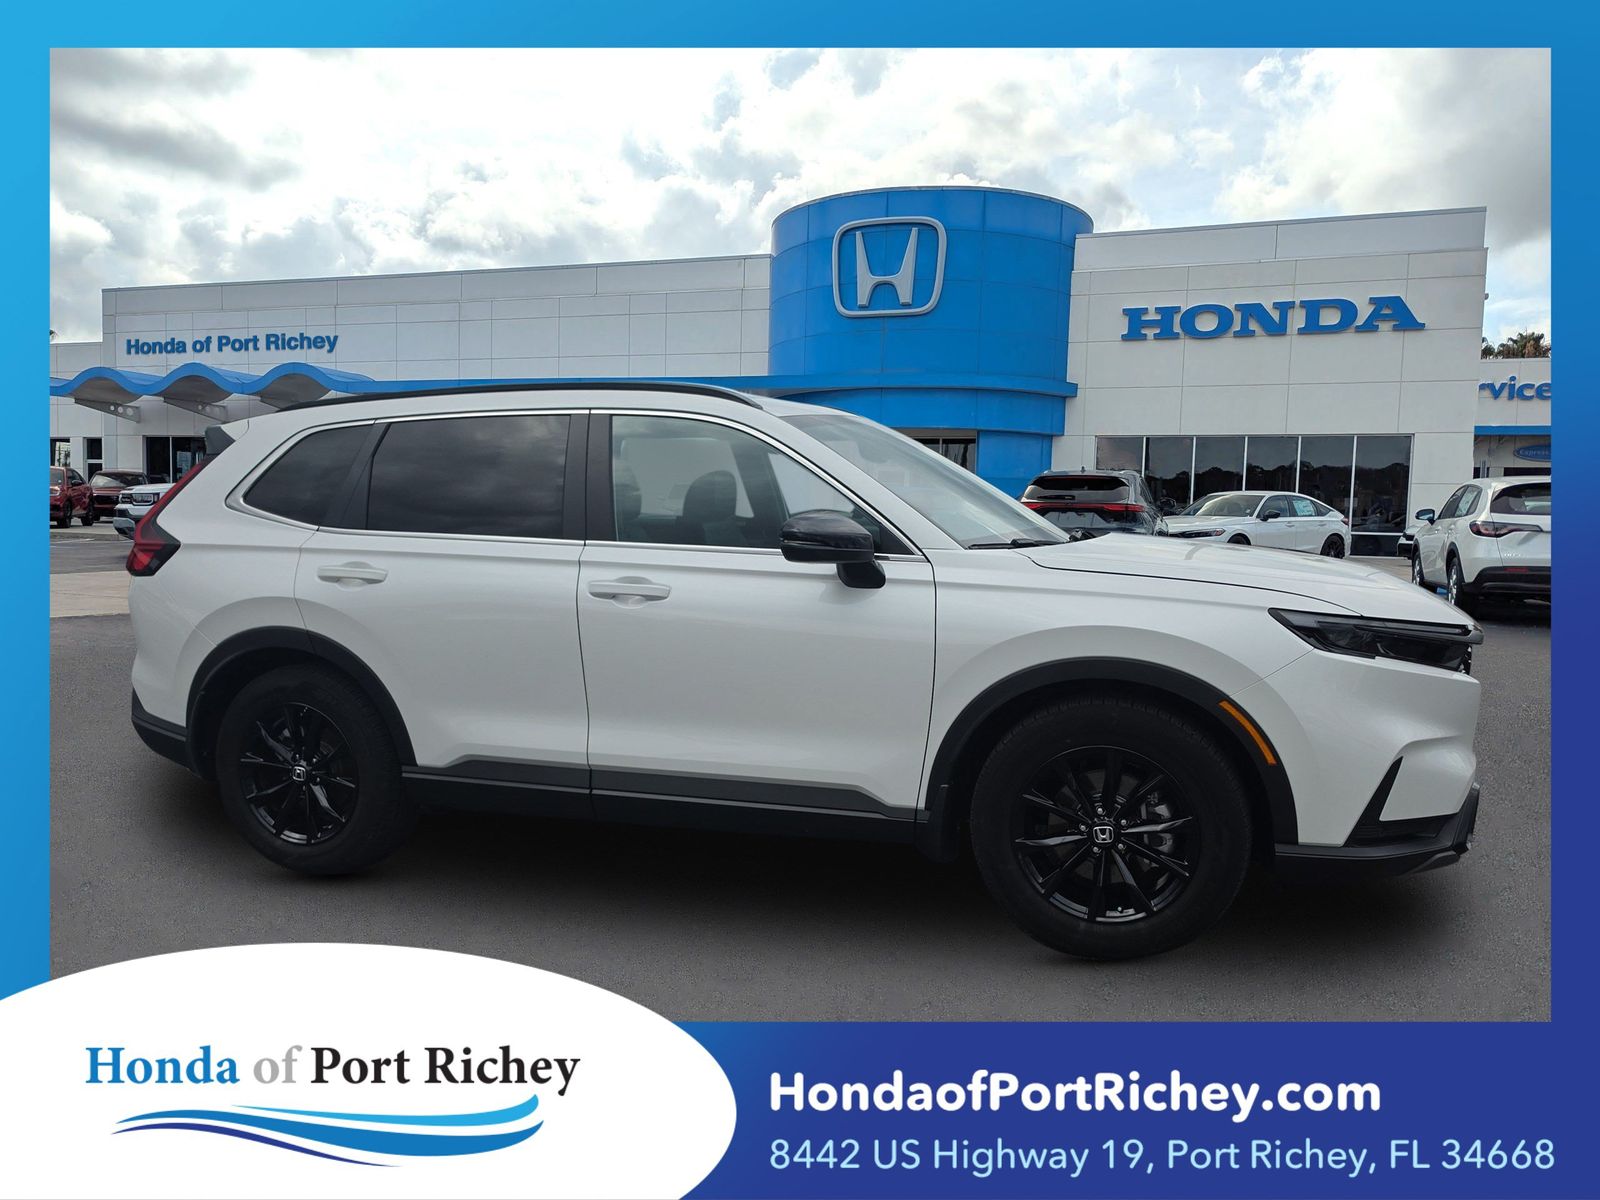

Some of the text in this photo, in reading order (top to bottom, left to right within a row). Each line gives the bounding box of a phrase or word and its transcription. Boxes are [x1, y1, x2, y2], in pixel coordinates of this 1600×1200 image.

[1120, 295, 1425, 341] HONDA
[126, 332, 339, 355] Honda of Port Richey
